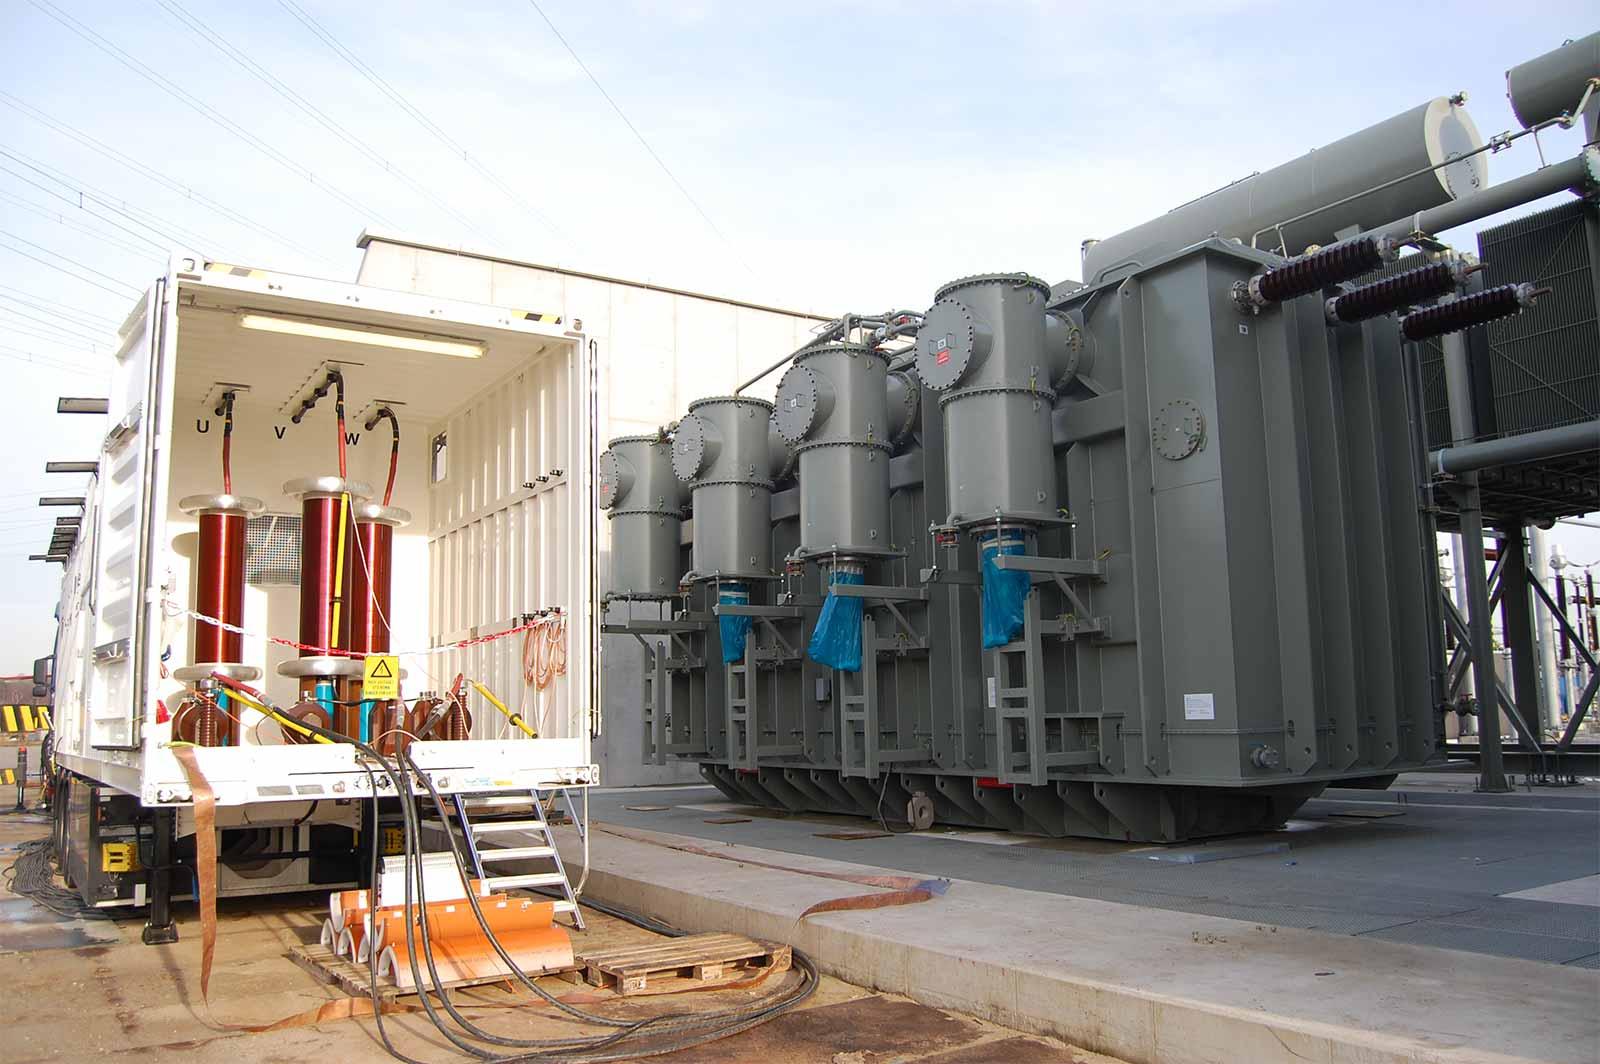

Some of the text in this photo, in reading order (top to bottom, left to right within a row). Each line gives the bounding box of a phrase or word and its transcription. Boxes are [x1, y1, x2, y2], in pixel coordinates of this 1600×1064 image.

[197, 419, 209, 433] U
[274, 426, 286, 439] V
[344, 432, 360, 445] W
